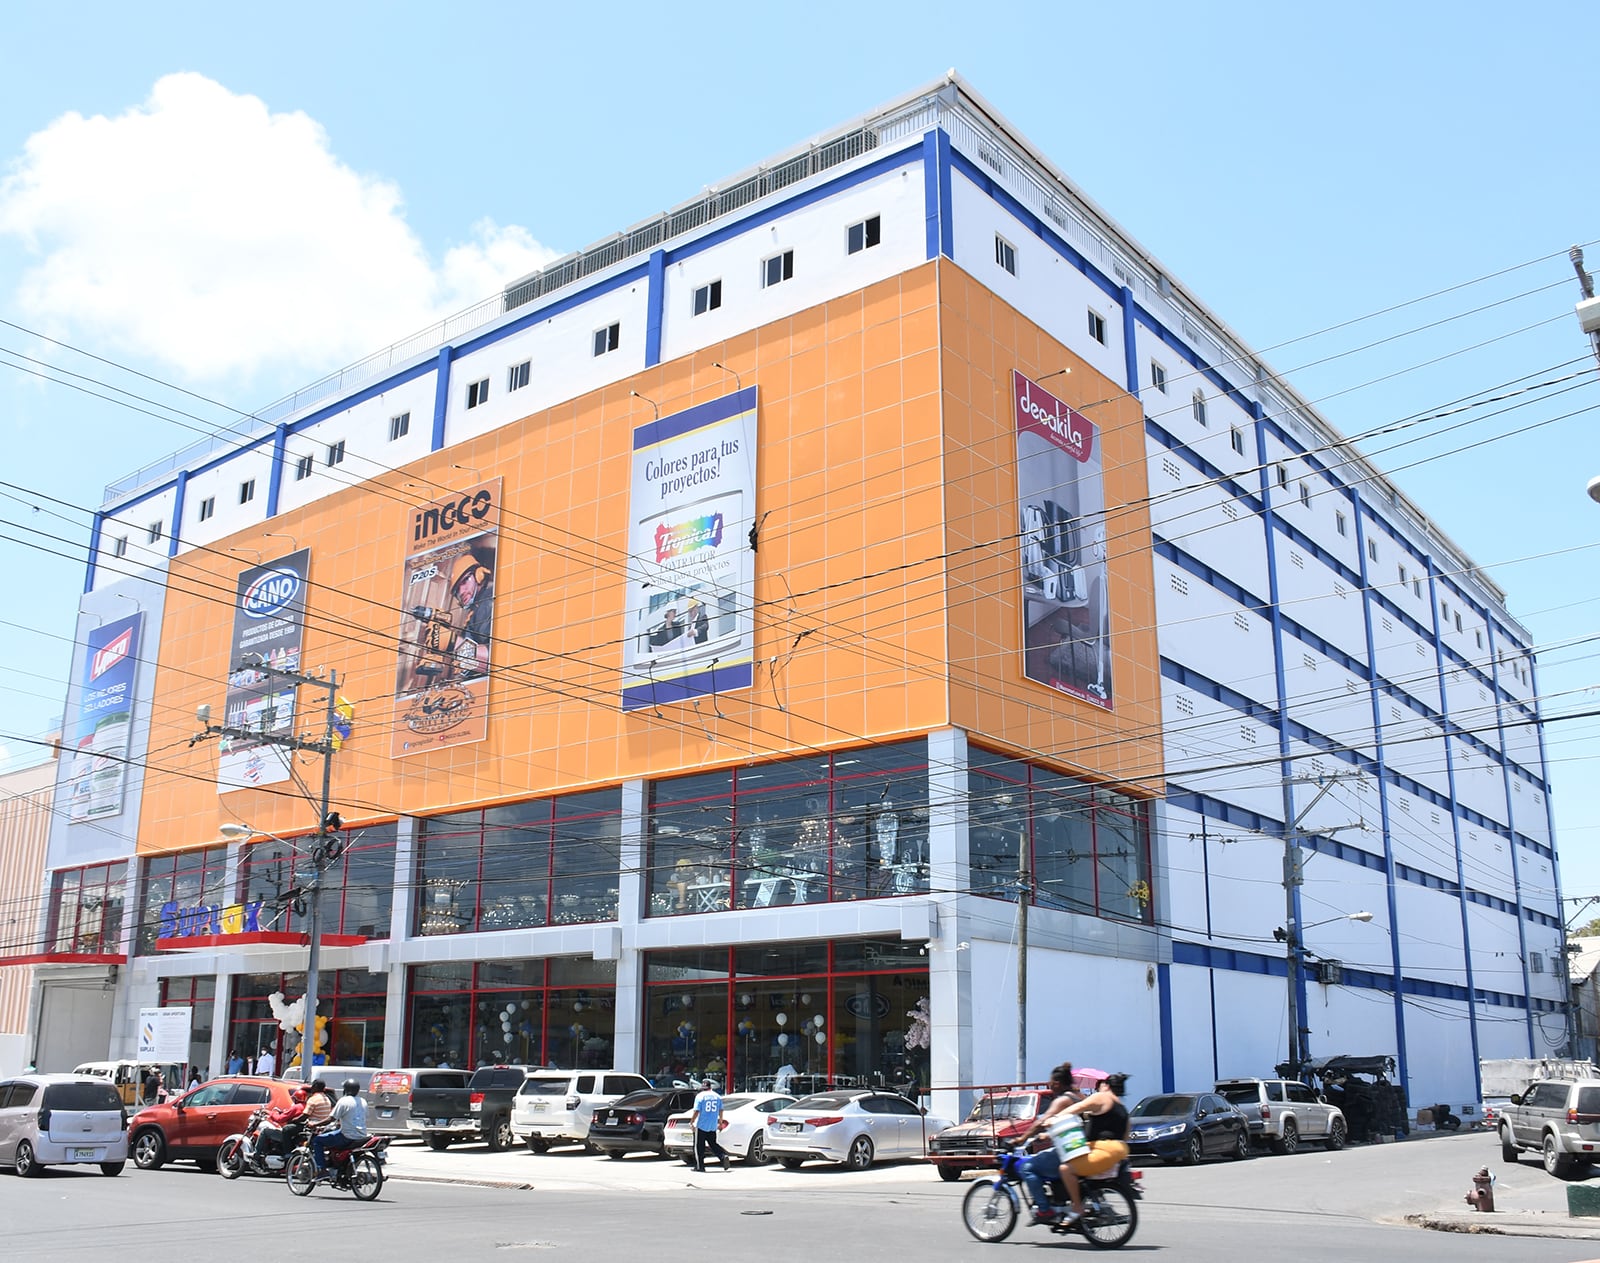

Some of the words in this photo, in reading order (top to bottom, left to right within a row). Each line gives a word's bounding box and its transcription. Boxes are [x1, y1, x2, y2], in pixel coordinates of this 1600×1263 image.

[1020, 380, 1082, 448] decakila
[645, 457, 688, 482] Colores
[691, 446, 718, 471] para
[721, 439, 739, 457] tus
[661, 456, 721, 499] proyectos!
[660, 518, 720, 554] Tropical
[249, 578, 293, 609] CANO
[705, 1100, 718, 1112] 85
